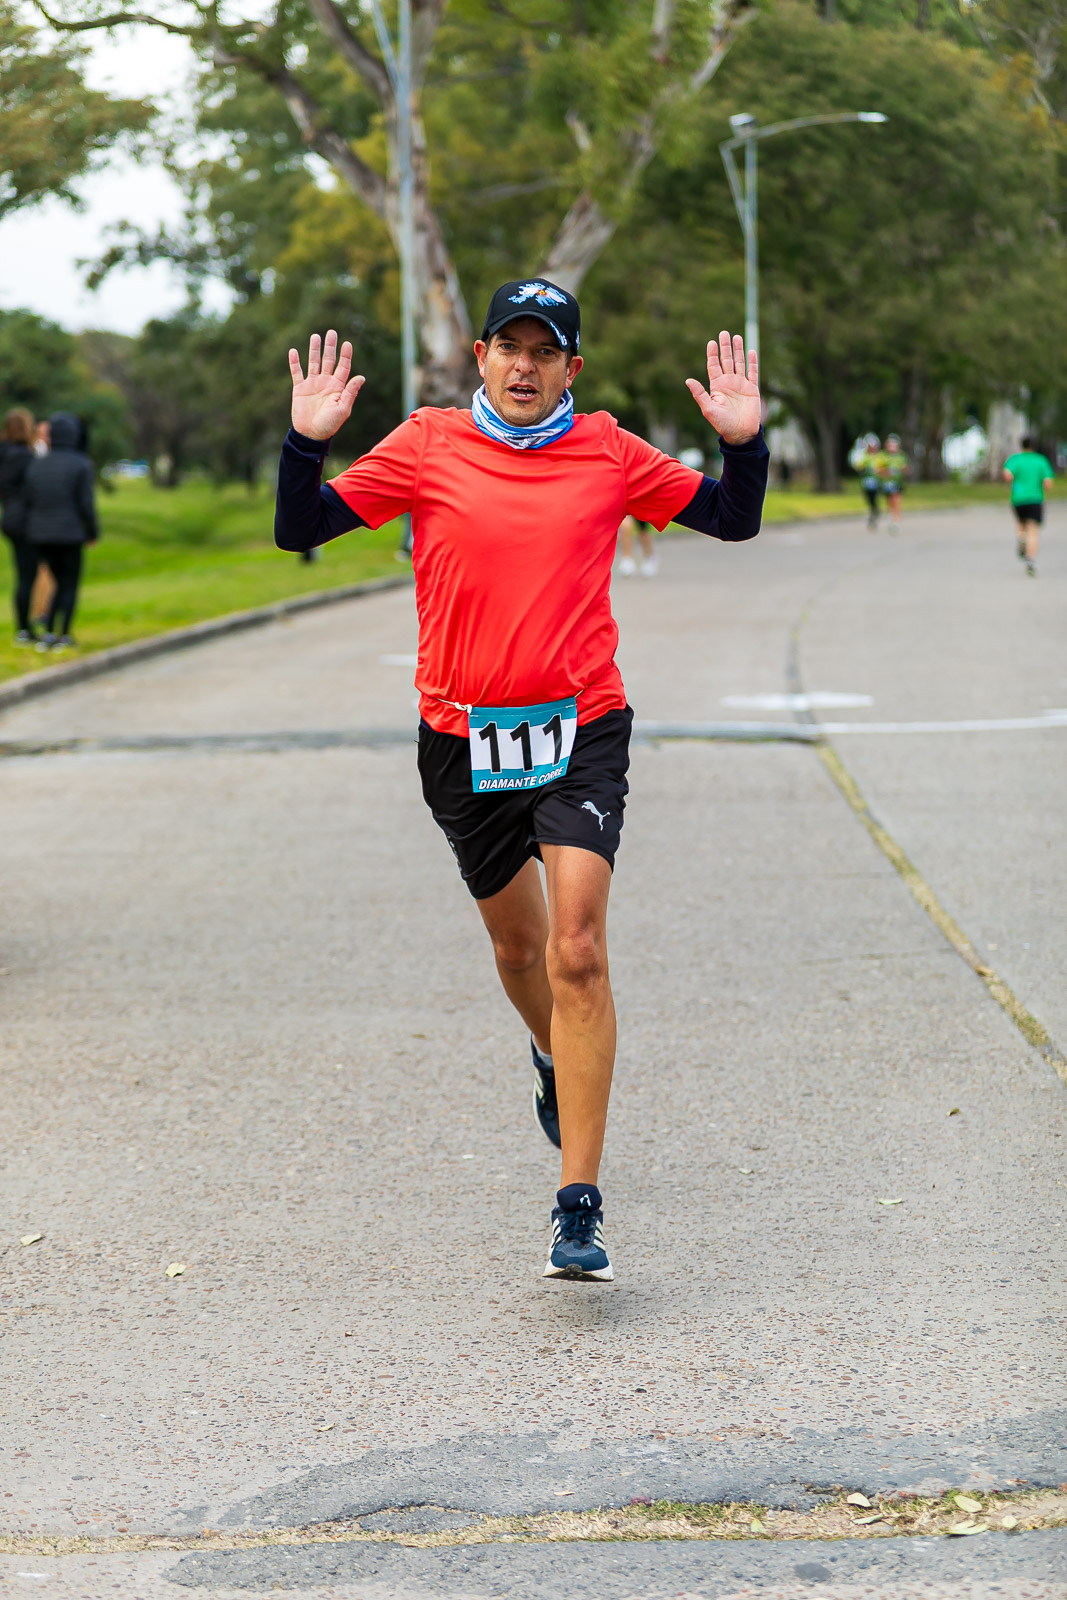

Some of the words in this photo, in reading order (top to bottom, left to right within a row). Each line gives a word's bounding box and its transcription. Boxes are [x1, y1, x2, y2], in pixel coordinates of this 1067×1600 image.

[479, 714, 563, 774] 111
[478, 776, 537, 790] DIAMANTE
[538, 766, 564, 784] CORRE
